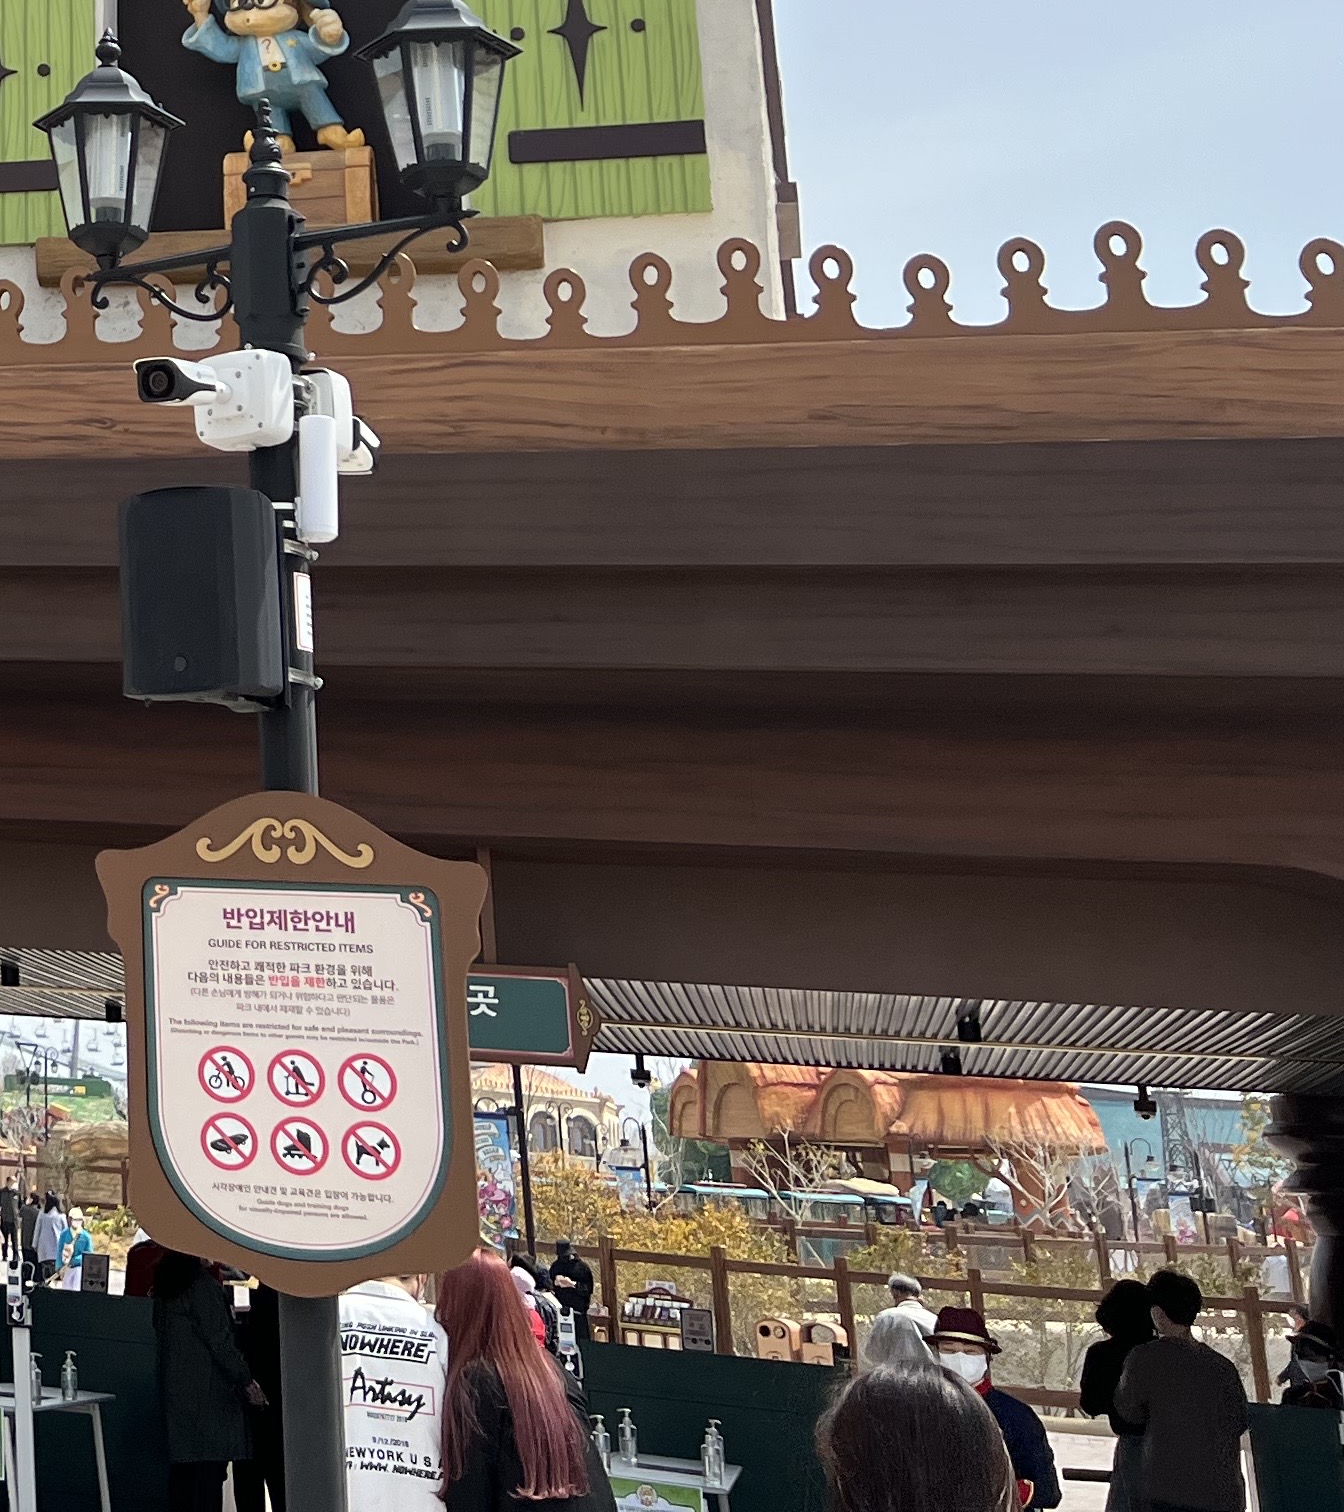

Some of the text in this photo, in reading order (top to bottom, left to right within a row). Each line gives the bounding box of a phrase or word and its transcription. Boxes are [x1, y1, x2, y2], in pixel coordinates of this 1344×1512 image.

[222, 907, 356, 934] 반입제한안내
[208, 938, 374, 954] GUIDE FOR RESTRICTED ITEMS
[208, 959, 373, 978] 안전하고 쾌적한 파크 환경을 위해
[187, 971, 400, 992] 다음의 내용들은 반입을 제한하고 있습니다.
[305, 1006, 313, 1015] 수
[466, 984, 500, 1018] 곳
[169, 1017, 182, 1026] The
[184, 1019, 218, 1029] following
[219, 1020, 240, 1028] items
[255, 1023, 290, 1031] restricted
[304, 1024, 319, 1033] safe
[337, 1026, 369, 1035] pleasant
